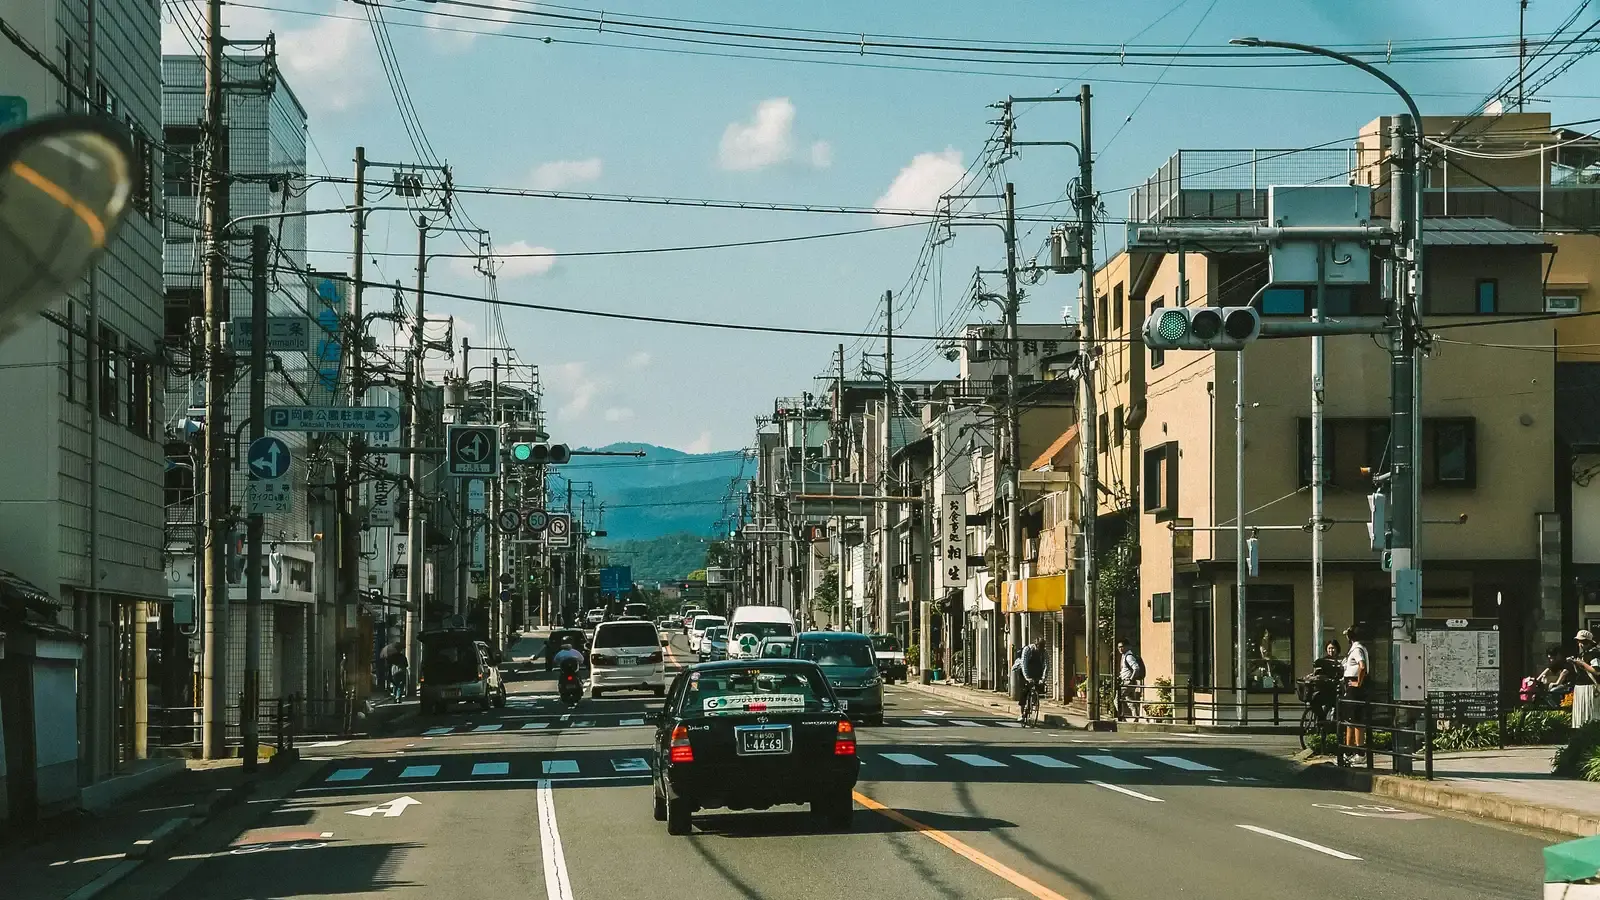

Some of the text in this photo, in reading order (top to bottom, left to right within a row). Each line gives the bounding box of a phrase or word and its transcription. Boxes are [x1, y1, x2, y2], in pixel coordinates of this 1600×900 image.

[240, 322, 304, 337] 東二条
[531, 515, 544, 526] 50
[753, 739, 782, 750] 44-69
